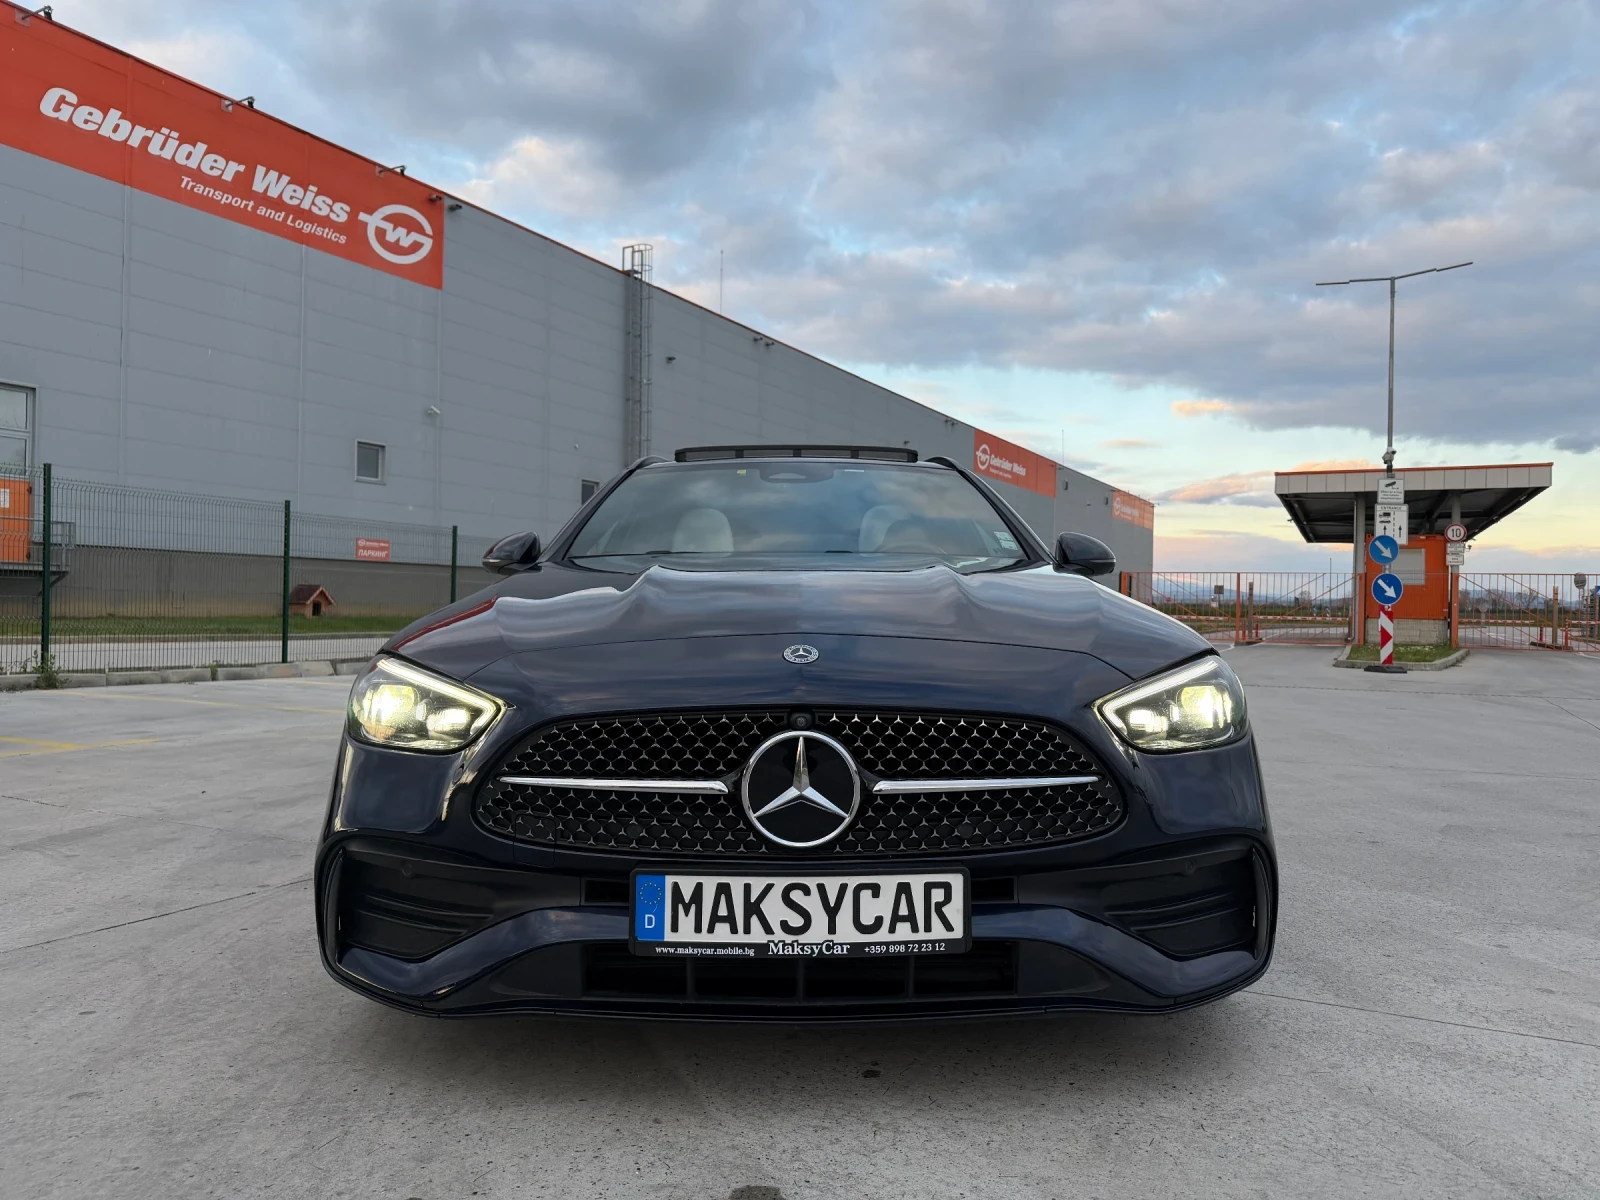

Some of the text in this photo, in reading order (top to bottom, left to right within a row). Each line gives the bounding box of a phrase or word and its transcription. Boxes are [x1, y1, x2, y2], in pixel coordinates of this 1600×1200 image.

[40, 87, 351, 223] Gebrüder Weiss
[180, 176, 347, 244] Transport and Logistics
[1452, 528, 1461, 538] 10
[671, 881, 955, 935] MAKSYCAR
[645, 914, 655, 928] D
[655, 946, 755, 956] www.maksycar.mobile.bg
[768, 940, 850, 955] MaksyCar
[889, 945, 905, 953] 898
[908, 944, 918, 952] 72
[922, 944, 931, 952] 23
[935, 943, 945, 951] 12
